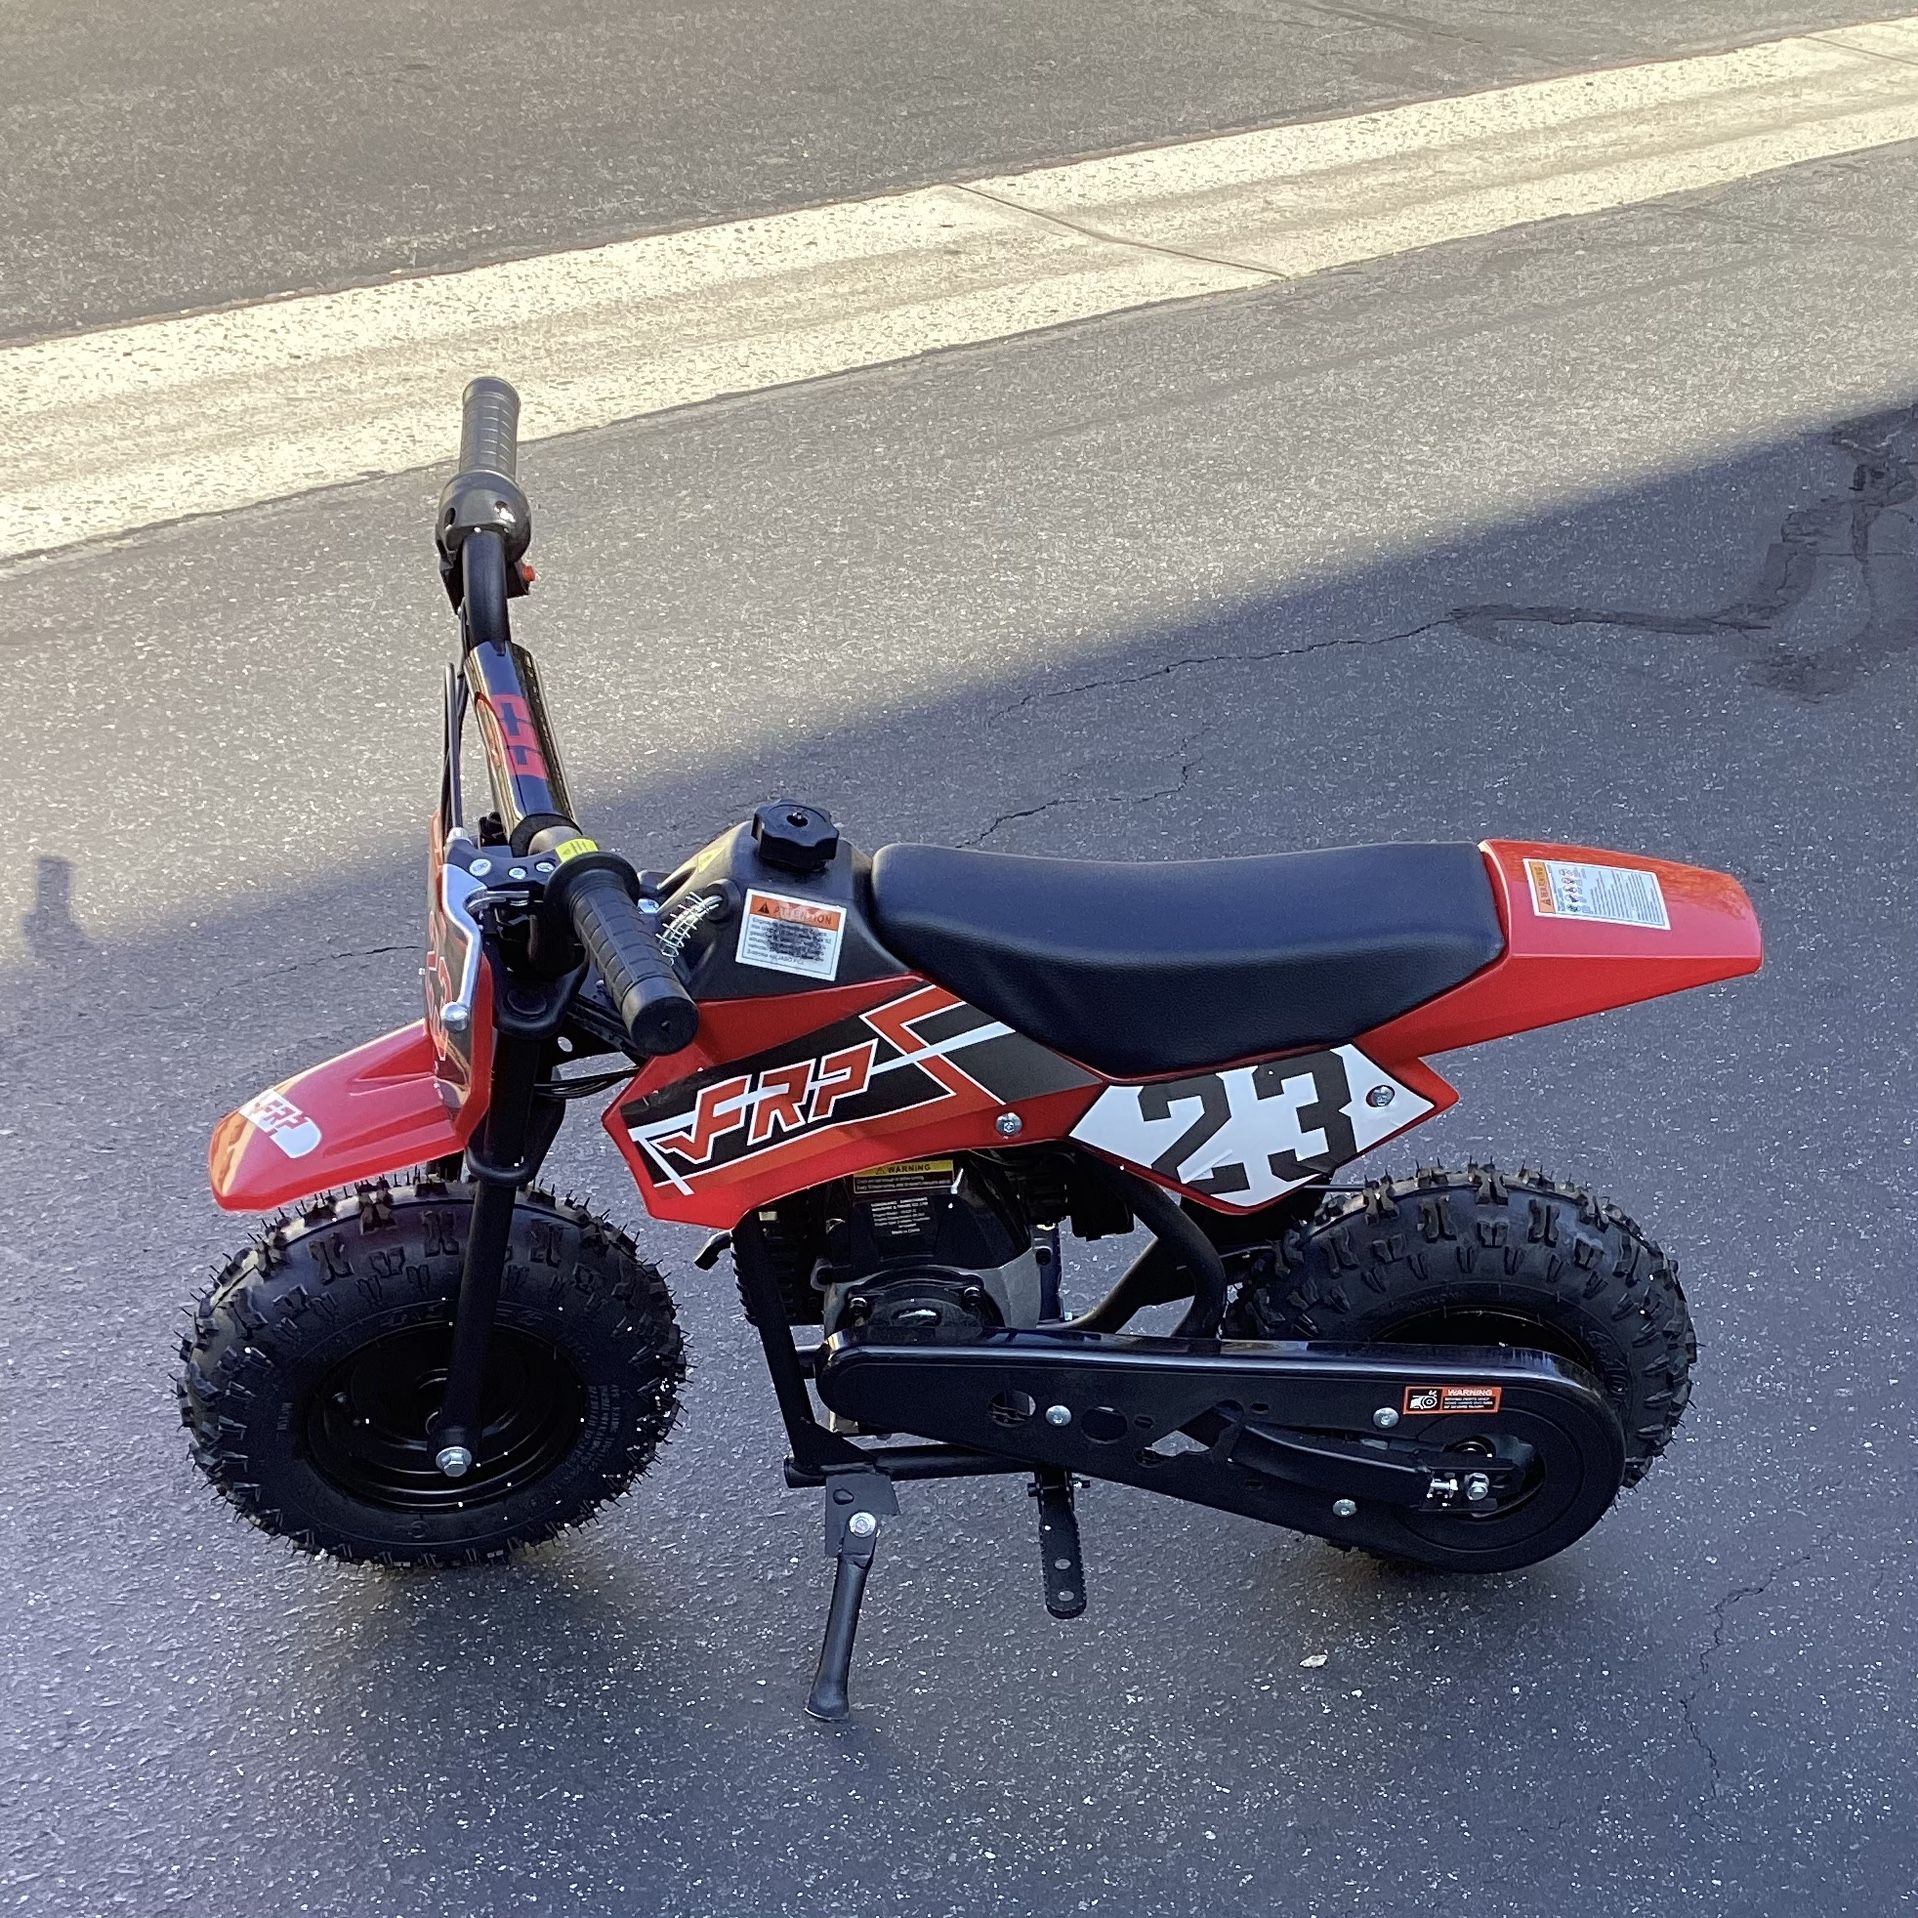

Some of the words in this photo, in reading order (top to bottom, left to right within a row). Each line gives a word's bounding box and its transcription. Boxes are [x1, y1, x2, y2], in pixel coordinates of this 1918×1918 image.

[652, 1038, 879, 1164] FRP
[1138, 1050, 1357, 1195] 23
[888, 1164, 931, 1174] WARNING
